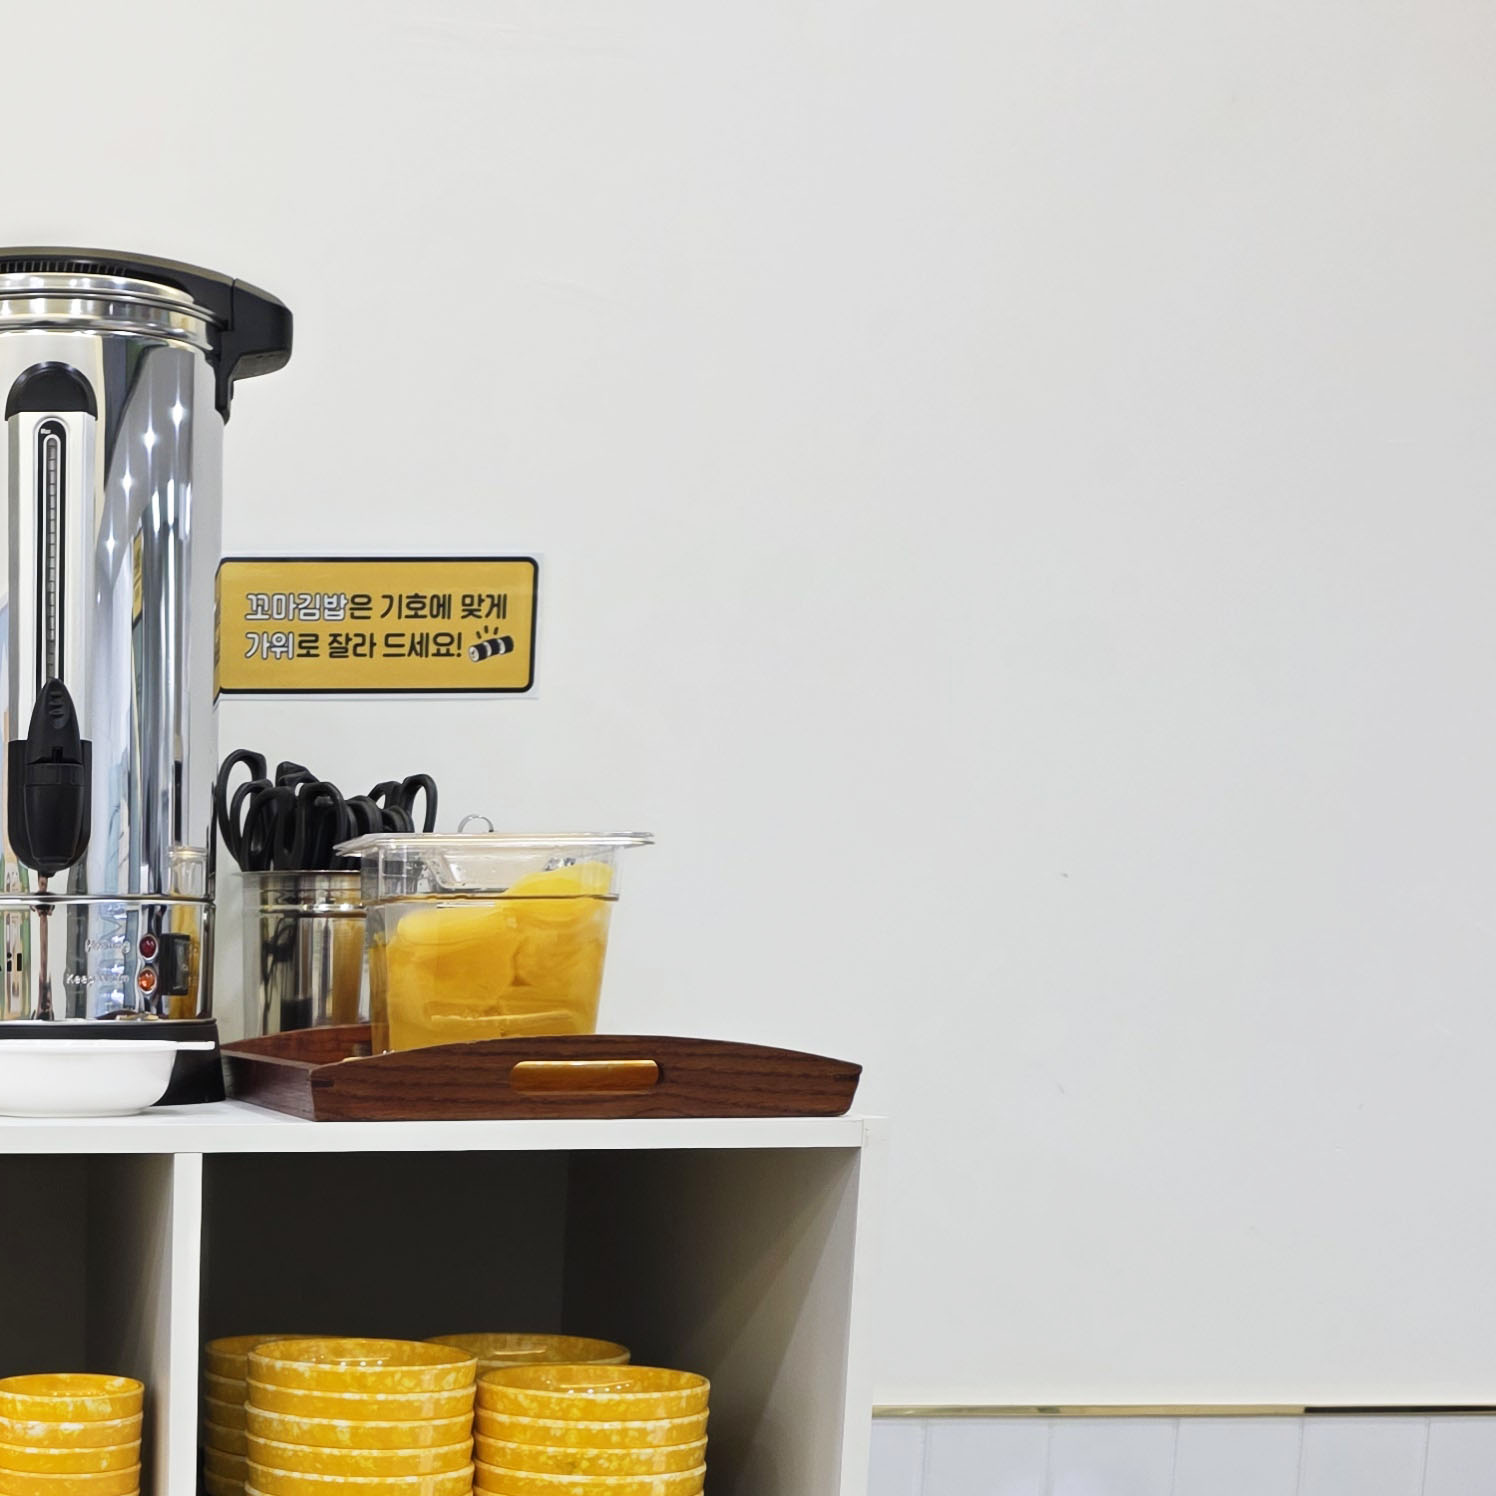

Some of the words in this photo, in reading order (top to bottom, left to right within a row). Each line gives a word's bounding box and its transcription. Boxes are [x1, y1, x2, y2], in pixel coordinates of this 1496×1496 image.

[380, 593, 452, 620] 기호에
[461, 593, 508, 620] 맞게
[244, 632, 321, 660] 가위로
[328, 632, 377, 659] 잘라
[383, 632, 462, 659] 드세요!
